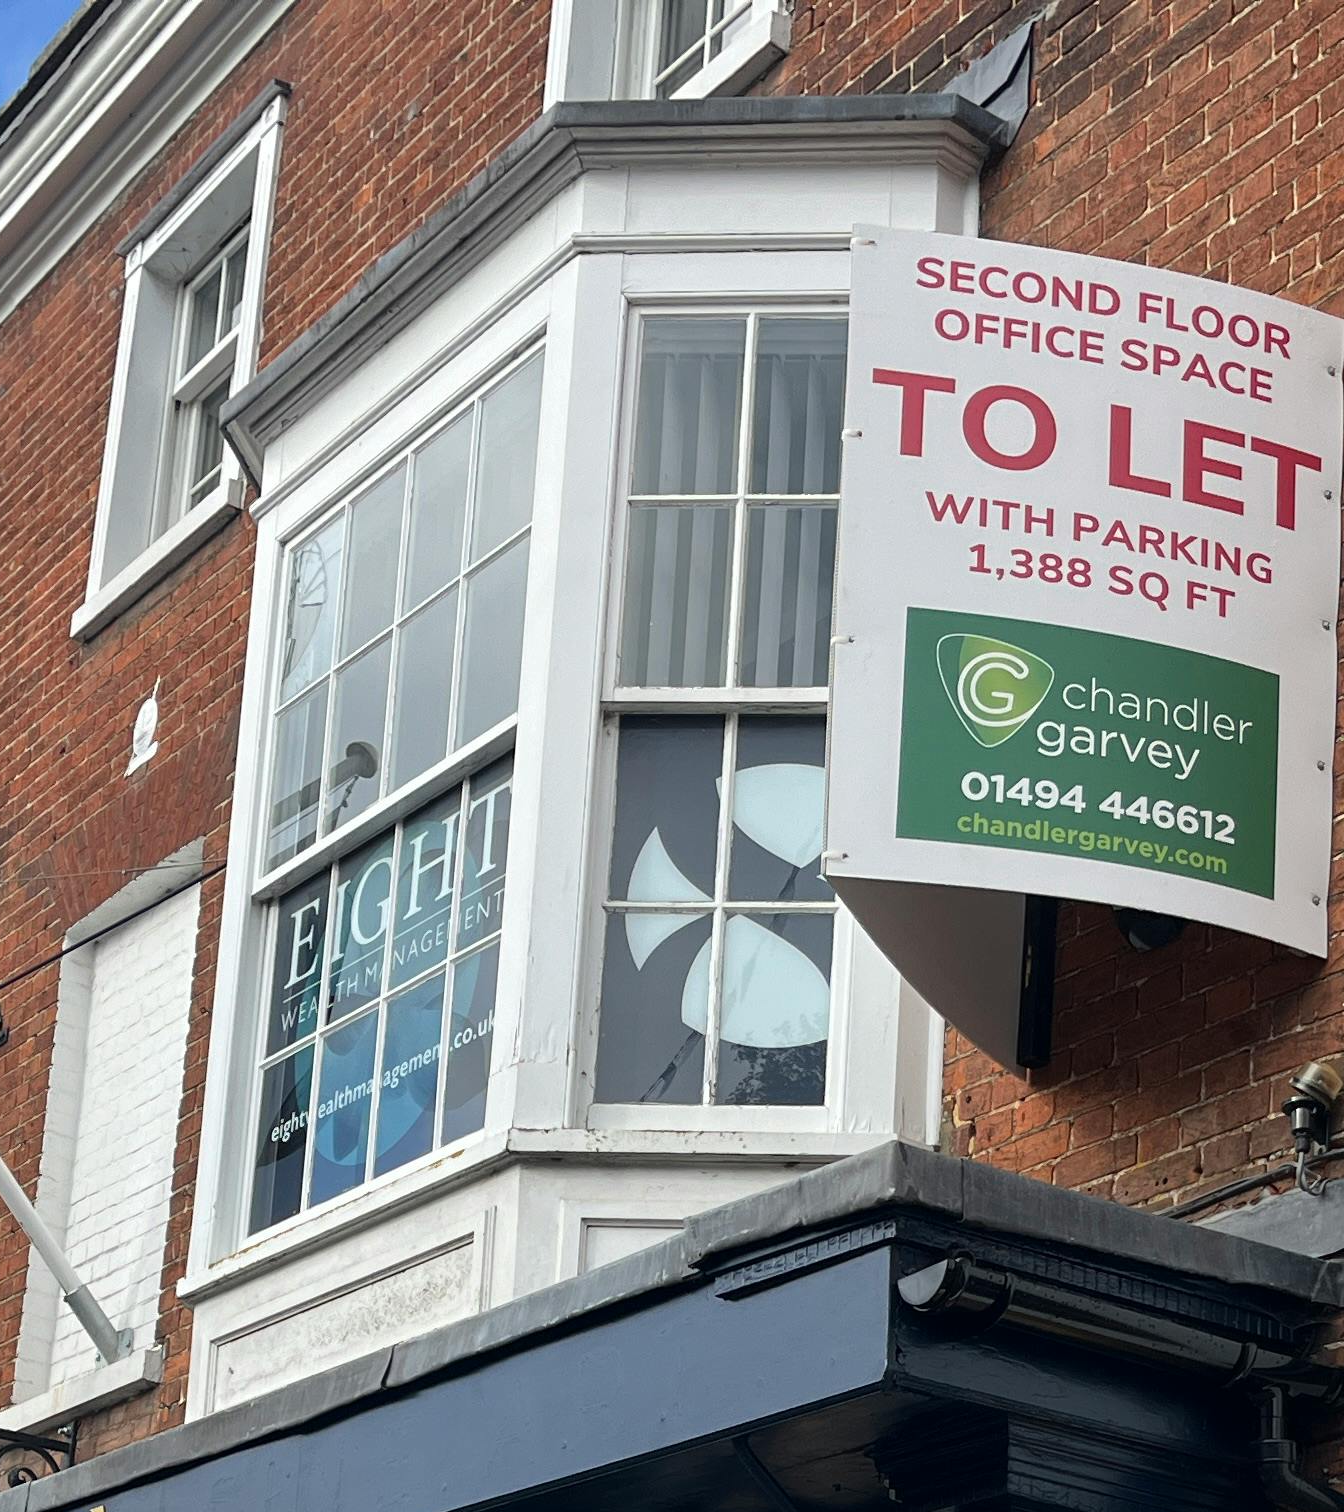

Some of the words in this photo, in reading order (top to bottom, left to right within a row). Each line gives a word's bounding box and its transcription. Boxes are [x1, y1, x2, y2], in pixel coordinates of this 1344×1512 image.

[916, 256, 1120, 317] SECOND
[1137, 295, 1292, 360] FLOOR
[934, 309, 1105, 366] OFFICE
[1120, 339, 1274, 402] SPACE
[872, 368, 1057, 471] TO
[1109, 404, 1322, 531] LET
[926, 491, 1055, 538] WITH
[1073, 512, 1273, 584] PARKING
[968, 544, 1093, 588] 1,388
[1108, 564, 1169, 612] SQ
[1186, 583, 1236, 618] FT
[1036, 714, 1200, 780] garvey
[1061, 676, 1253, 745] chandler
[957, 812, 1228, 875] chandlergarvey.com
[961, 771, 1087, 815] 01494
[1099, 790, 1236, 845] 446612
[284, 785, 512, 990] EIGHT
[365, 889, 505, 987] MNAGEENT
